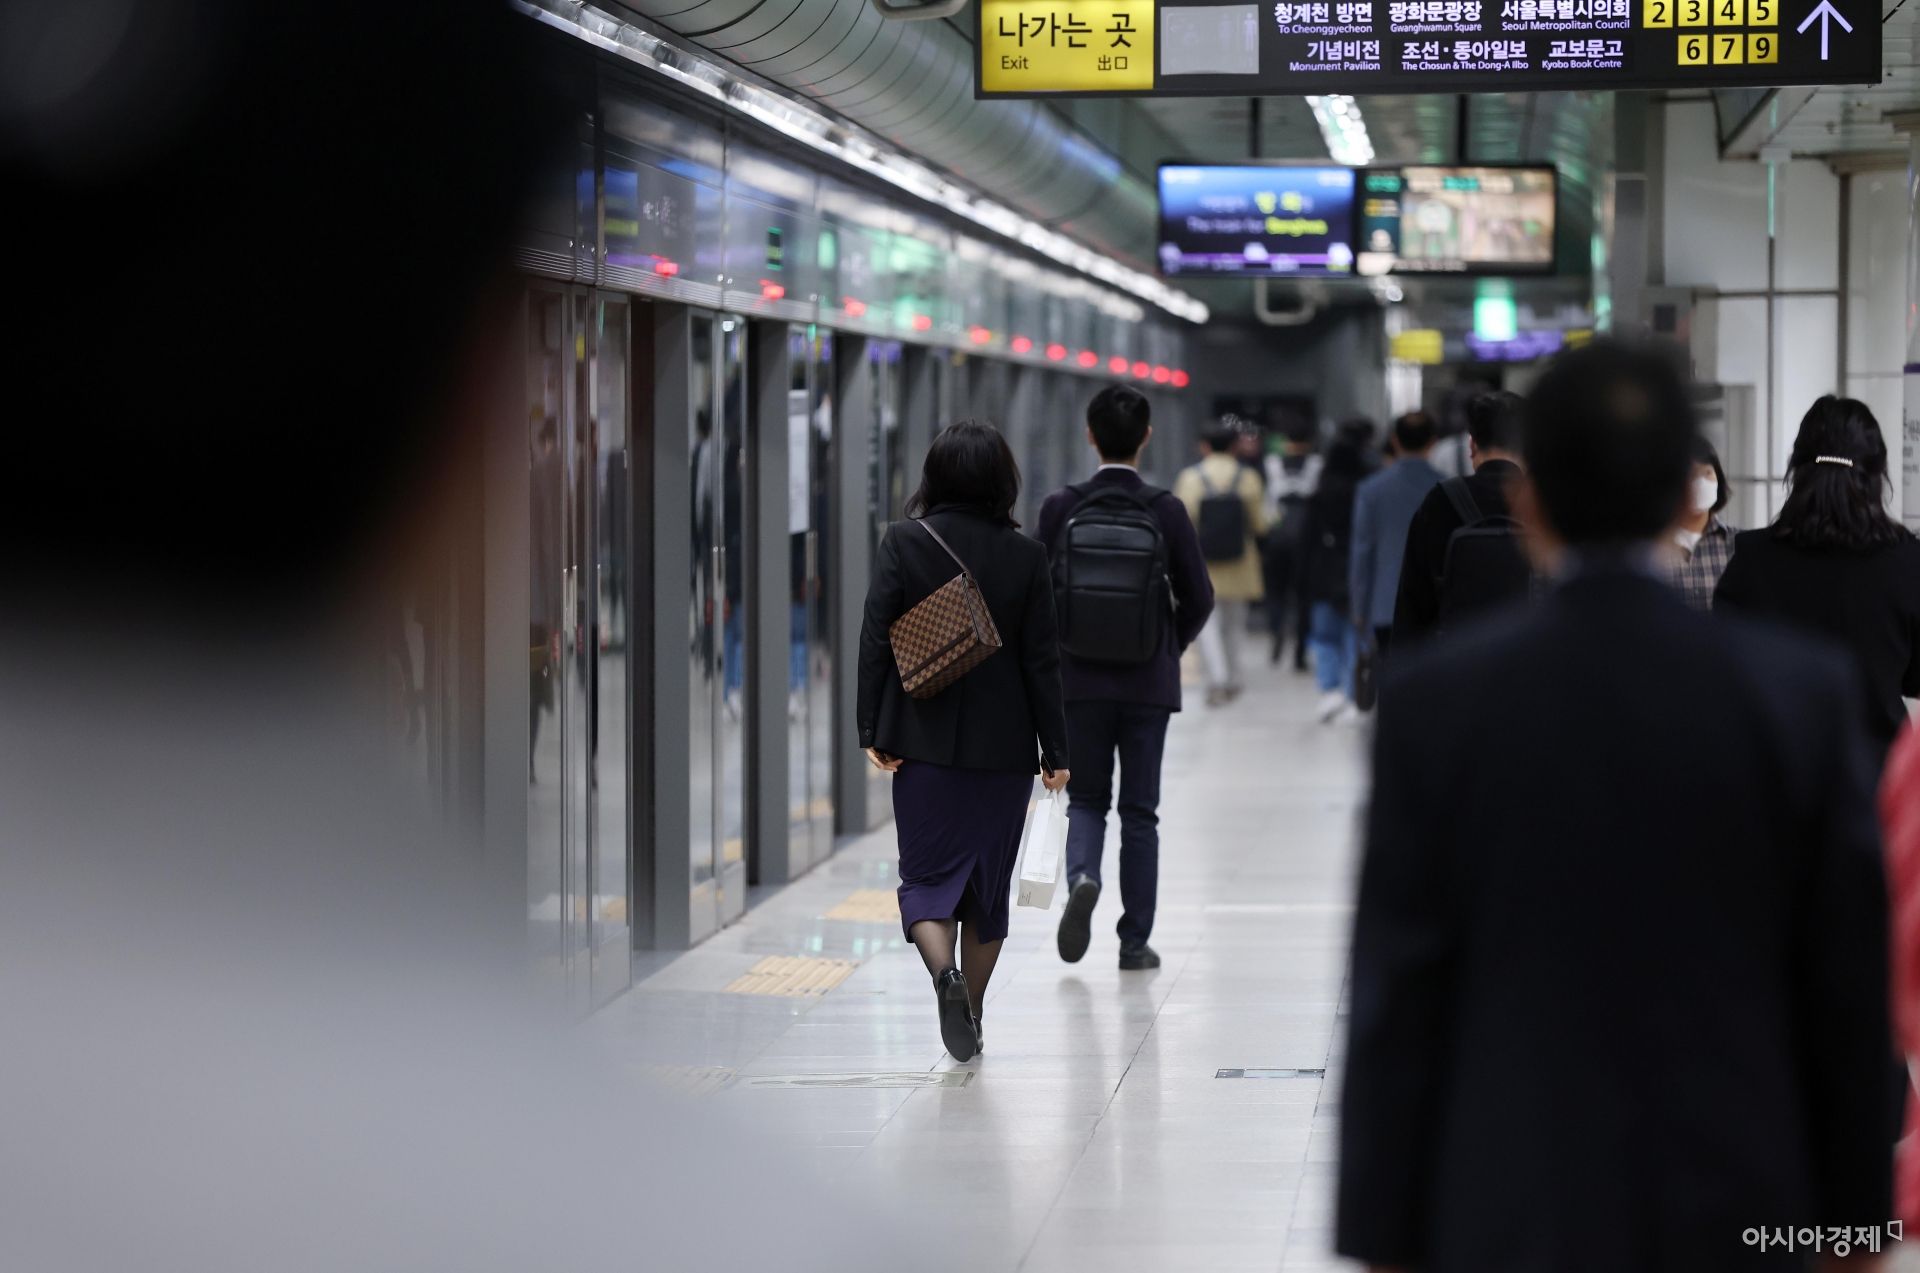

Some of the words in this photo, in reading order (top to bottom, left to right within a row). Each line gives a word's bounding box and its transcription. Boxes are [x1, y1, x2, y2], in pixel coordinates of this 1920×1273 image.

[1274, 3, 1329, 23] 청계천
[1336, 3, 1372, 23] 방면
[1389, 1, 1482, 22] 광화문광장
[1501, 0, 1630, 20] 서울특별시의회
[1652, 1, 1666, 23] 2
[1687, 0, 1700, 22] 3
[1721, 0, 1736, 21] 4
[1756, 0, 1770, 21] 5
[999, 13, 1092, 48] 나가는
[1106, 14, 1136, 48] 곳
[1279, 24, 1290, 34] To
[1292, 24, 1373, 35] Cheonggyecheon
[1390, 23, 1453, 34] Gwanghwamun
[1454, 23, 1482, 33] Square
[1502, 21, 1528, 31] Seoul
[1530, 20, 1593, 32] Metropolitan
[1595, 19, 1630, 30] Council
[1307, 40, 1380, 60] 기념비전
[1549, 40, 1624, 58] 교보문고
[1686, 38, 1700, 60] 6
[1721, 38, 1735, 59] 7
[1756, 37, 1770, 59] 9
[1001, 55, 1028, 70] Exit
[1098, 55, 1128, 71] 出口
[1289, 61, 1341, 71] Monument
[1343, 61, 1380, 71] Pavilion
[1402, 61, 1418, 70] The
[1419, 61, 1451, 70] Chosun
[1452, 61, 1460, 70] &
[1460, 61, 1477, 70] The
[1478, 61, 1511, 71] Dong-A
[1512, 60, 1529, 69] Ilbo
[1542, 60, 1569, 70] Kyobo
[1570, 60, 1592, 69] Book
[1593, 60, 1622, 68] Centre
